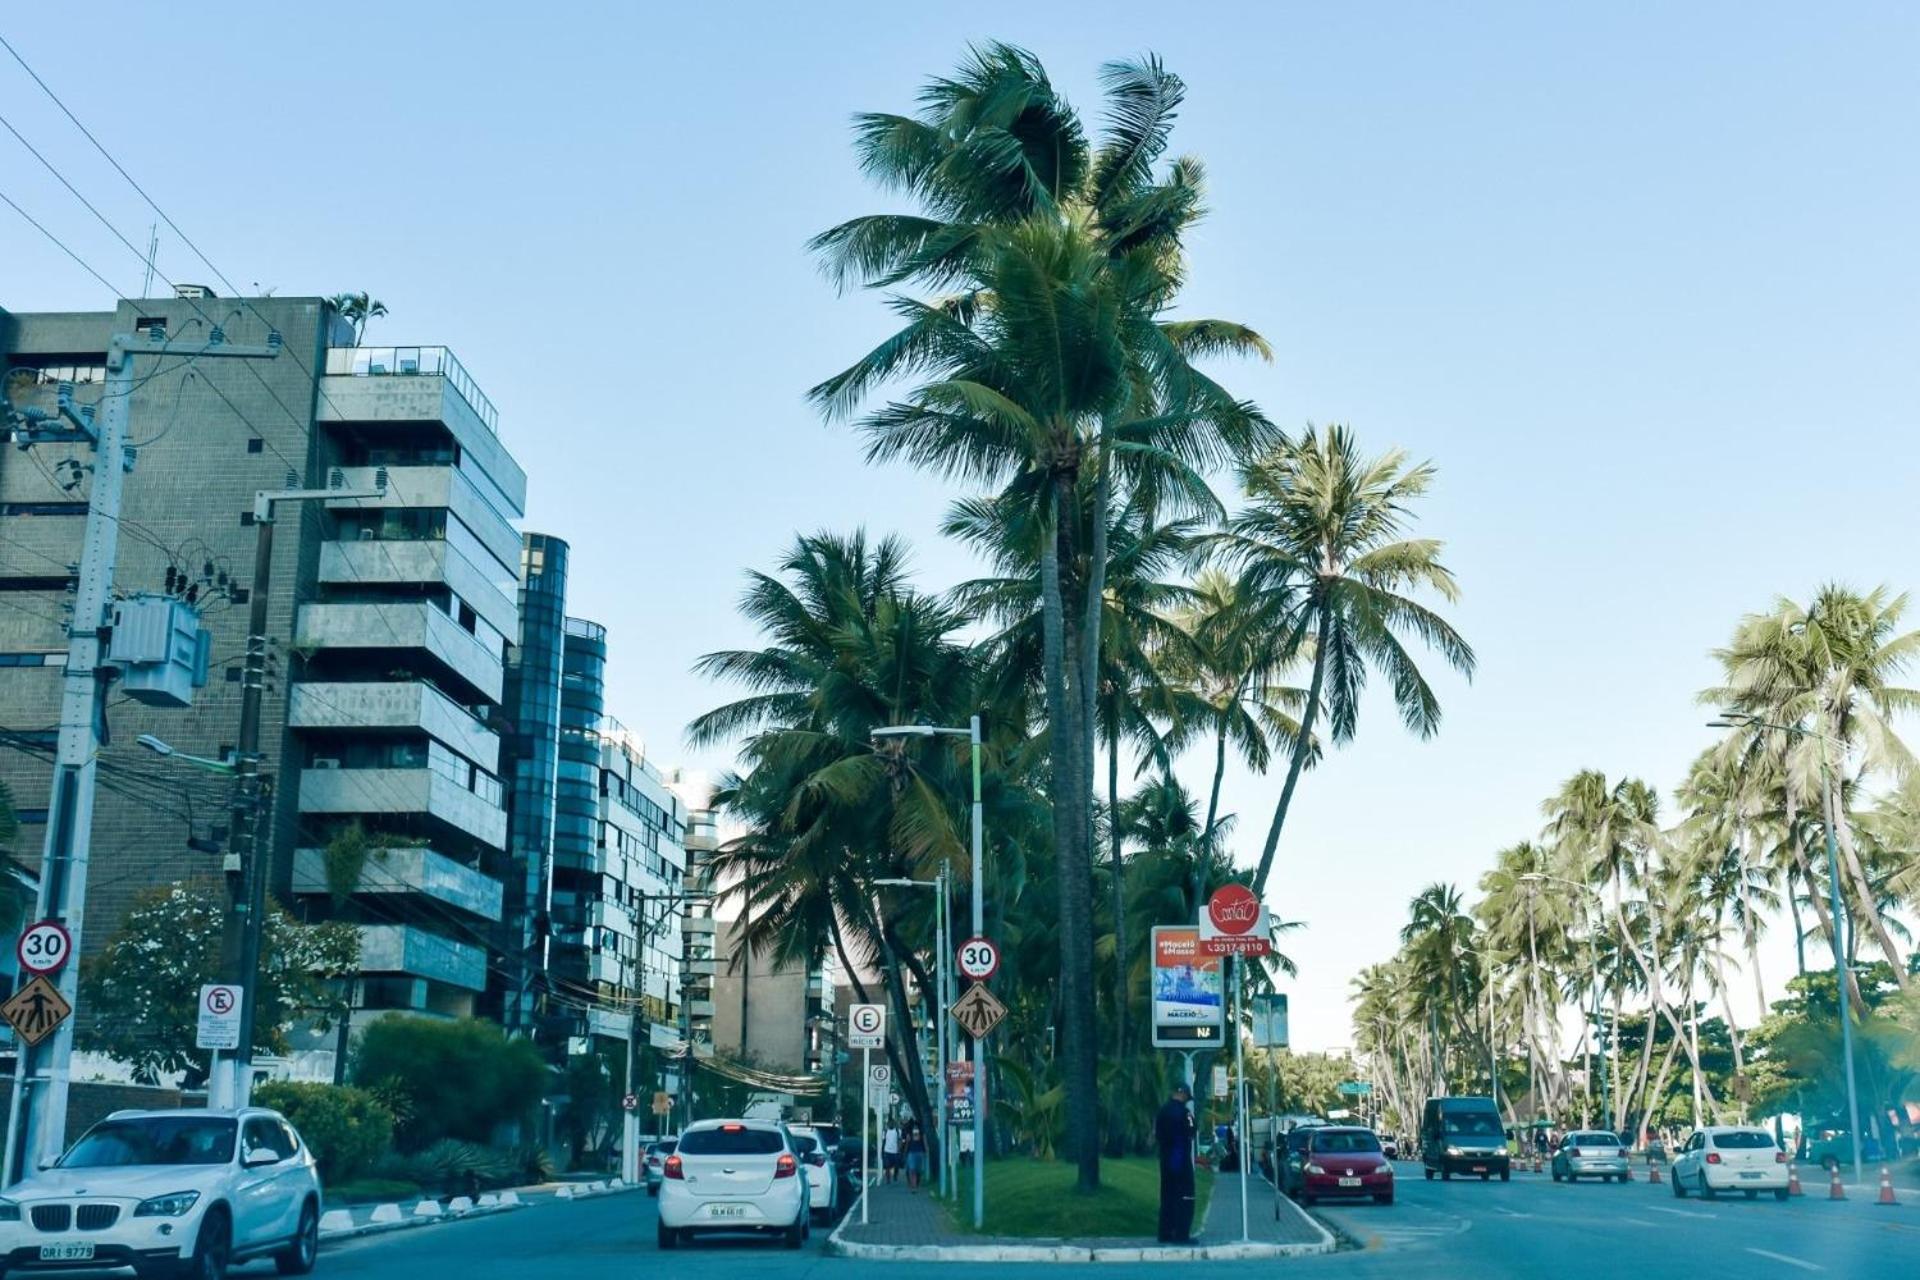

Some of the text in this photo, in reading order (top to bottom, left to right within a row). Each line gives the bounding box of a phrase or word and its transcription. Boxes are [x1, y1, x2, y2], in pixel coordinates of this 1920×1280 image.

[27, 934, 61, 956] 30
[965, 947, 992, 965] 30
[863, 1013, 873, 1027] E
[878, 1069, 884, 1078] E
